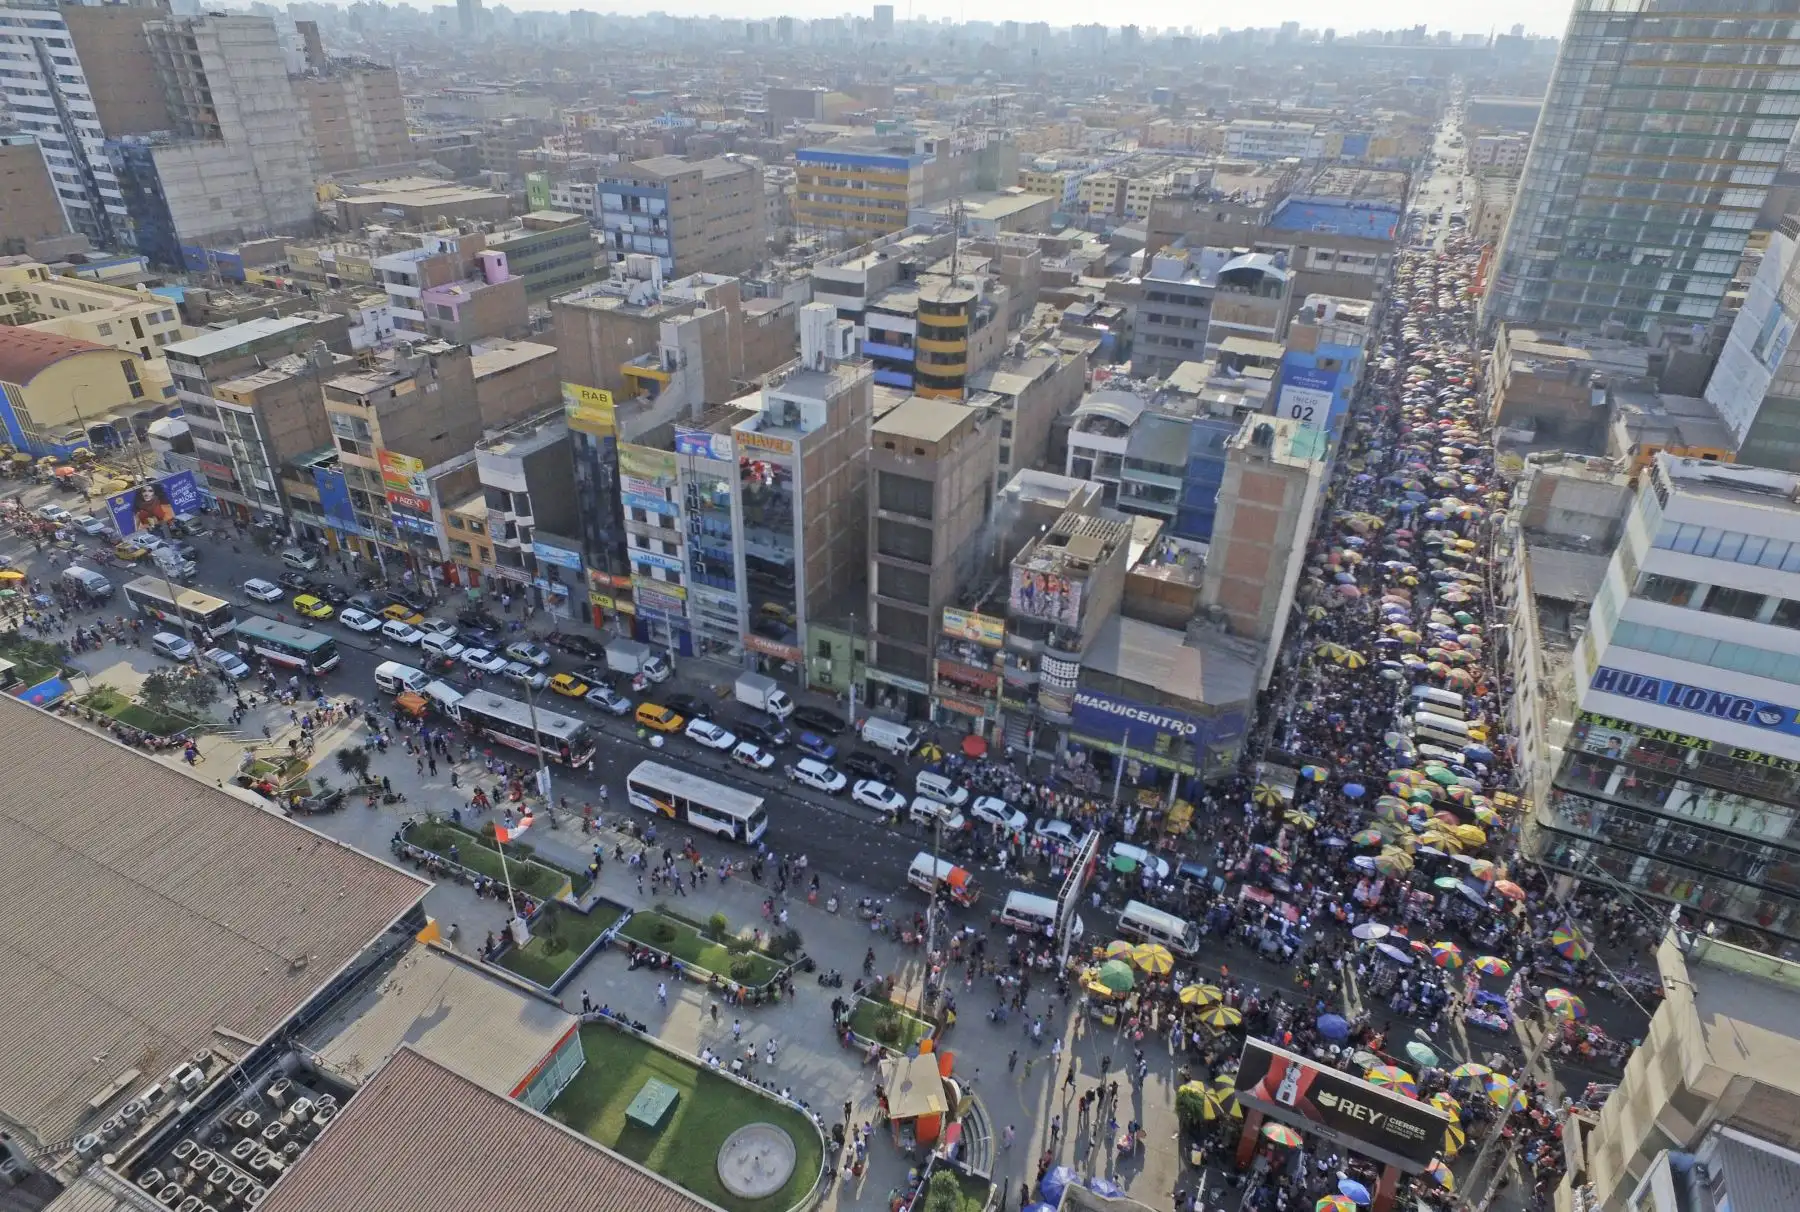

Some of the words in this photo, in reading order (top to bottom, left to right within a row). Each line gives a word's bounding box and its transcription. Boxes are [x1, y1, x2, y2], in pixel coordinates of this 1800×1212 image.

[582, 390, 608, 402] RAB
[1291, 404, 1314, 421] 02
[1594, 667, 1663, 701] HUA
[1667, 681, 1757, 725] LONG
[1074, 693, 1197, 735] MAQUICENTRO
[1337, 1098, 1383, 1125] REY
[1389, 1117, 1426, 1136] CIERRES
